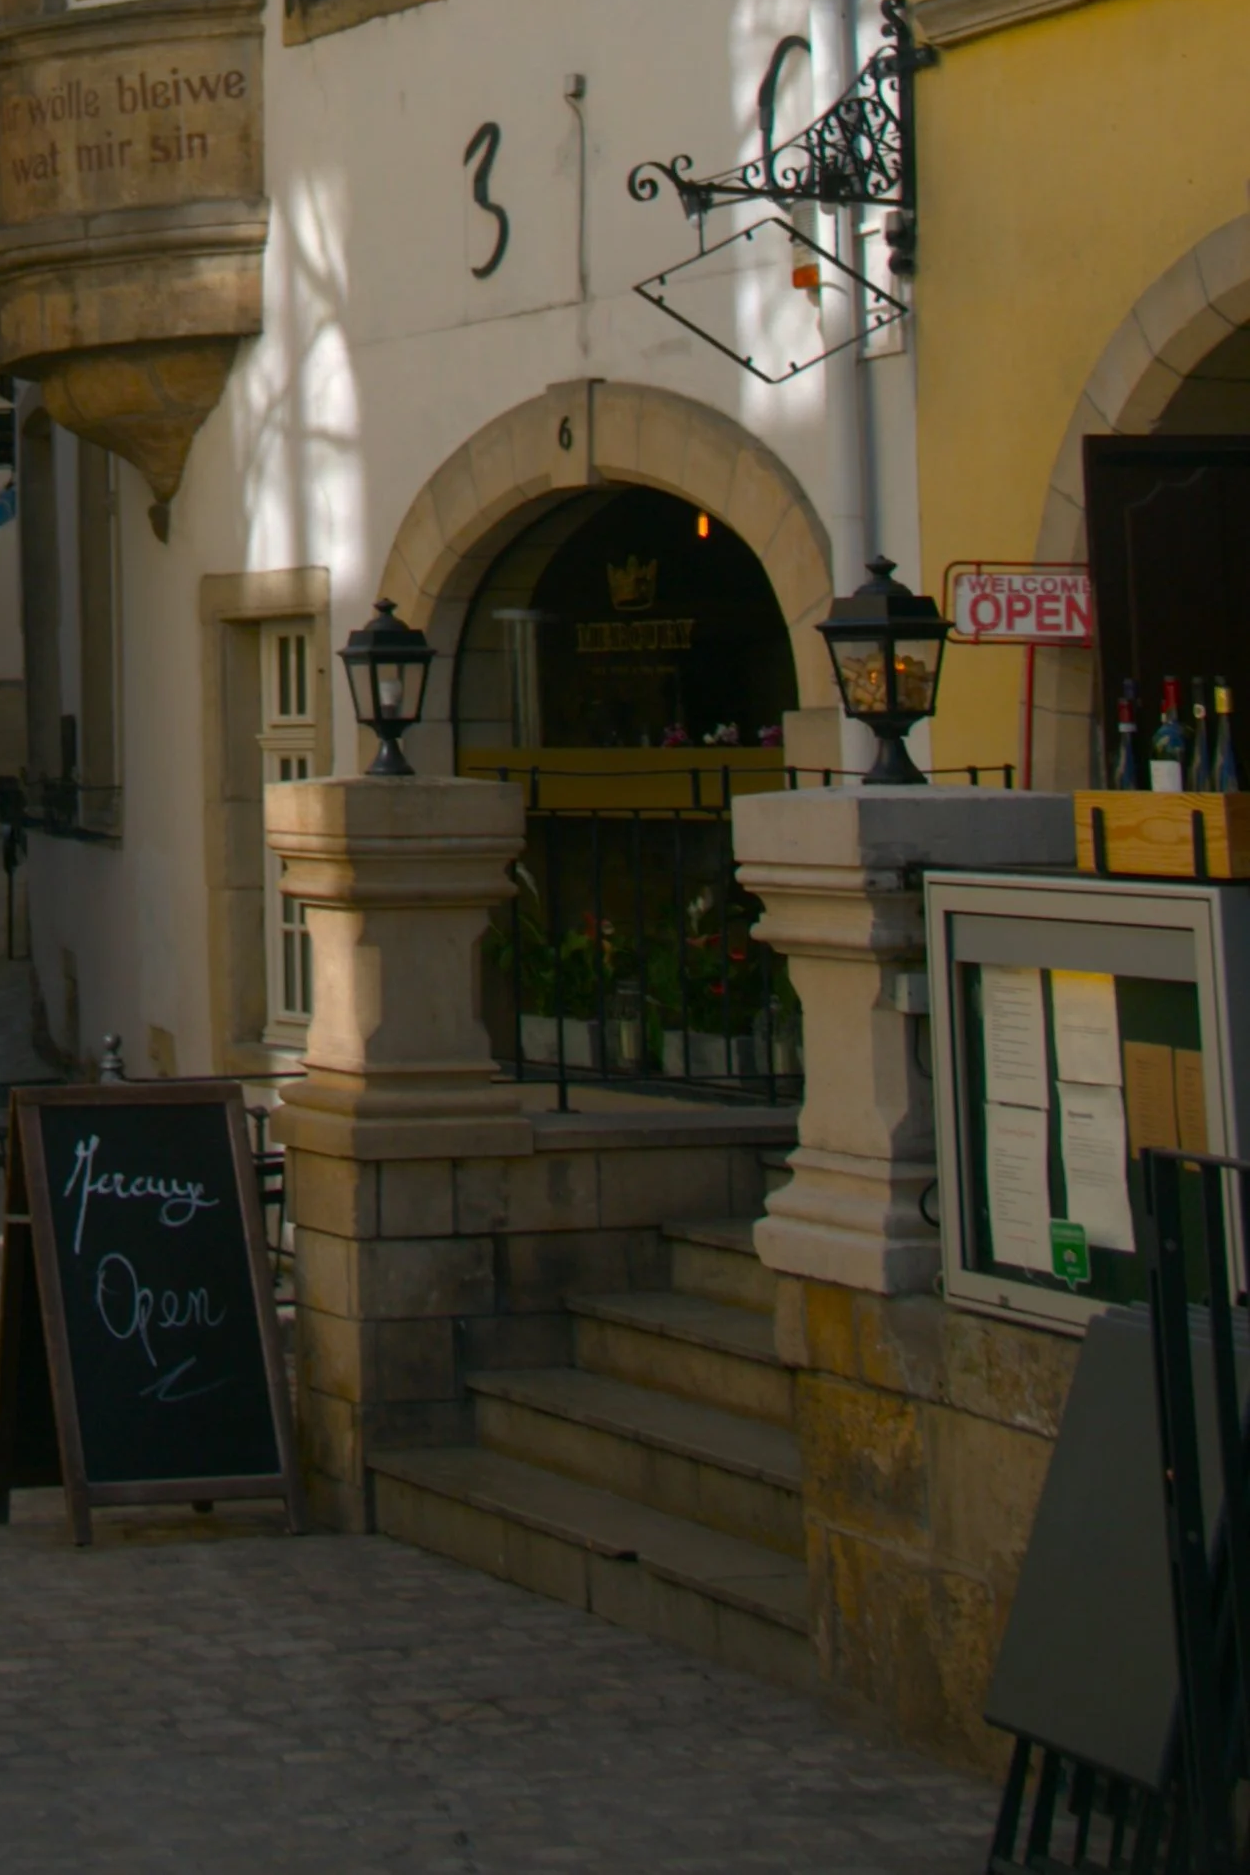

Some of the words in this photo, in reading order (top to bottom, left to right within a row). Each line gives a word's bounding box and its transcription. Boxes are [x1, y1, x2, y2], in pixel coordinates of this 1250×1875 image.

[29, 80, 101, 126] wölle
[116, 66, 247, 115] bleiwe
[12, 140, 61, 187] wat
[76, 130, 133, 173] mir
[150, 126, 209, 164] sin
[558, 415, 573, 452] 6
[967, 577, 1091, 595] WELCOME
[969, 594, 1093, 633] OPEN
[94, 1251, 228, 1369] Open
